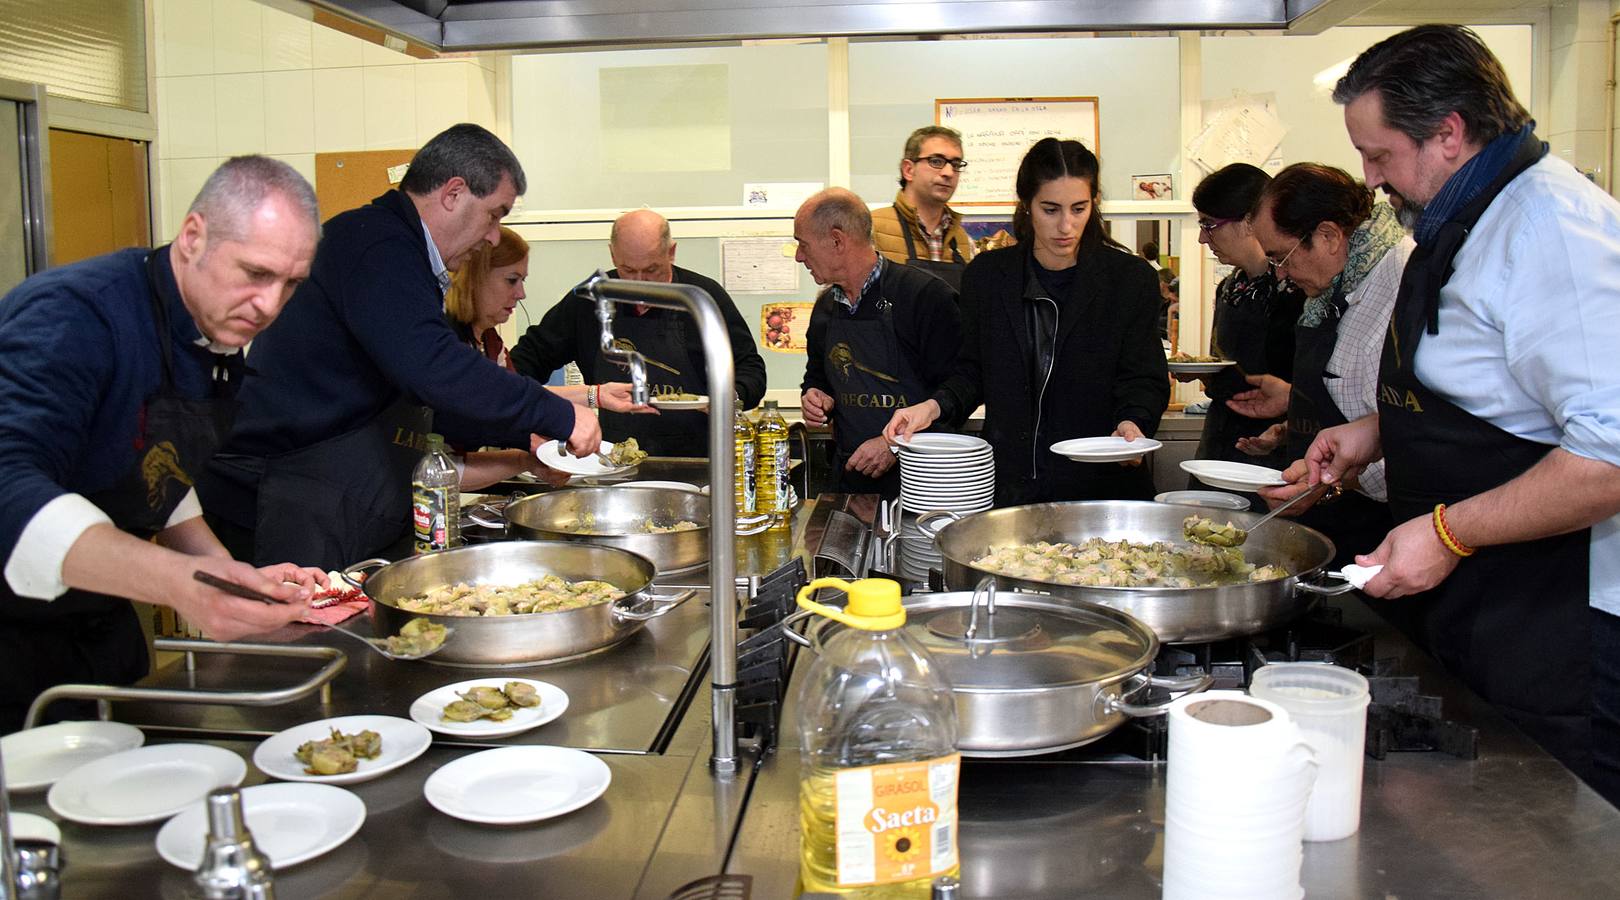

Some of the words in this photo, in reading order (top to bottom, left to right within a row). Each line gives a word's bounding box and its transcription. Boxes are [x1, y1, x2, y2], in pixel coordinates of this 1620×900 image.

[840, 392, 908, 408] BECADA
[874, 780, 927, 798] GIRASOL
[870, 805, 937, 833] Saeta
